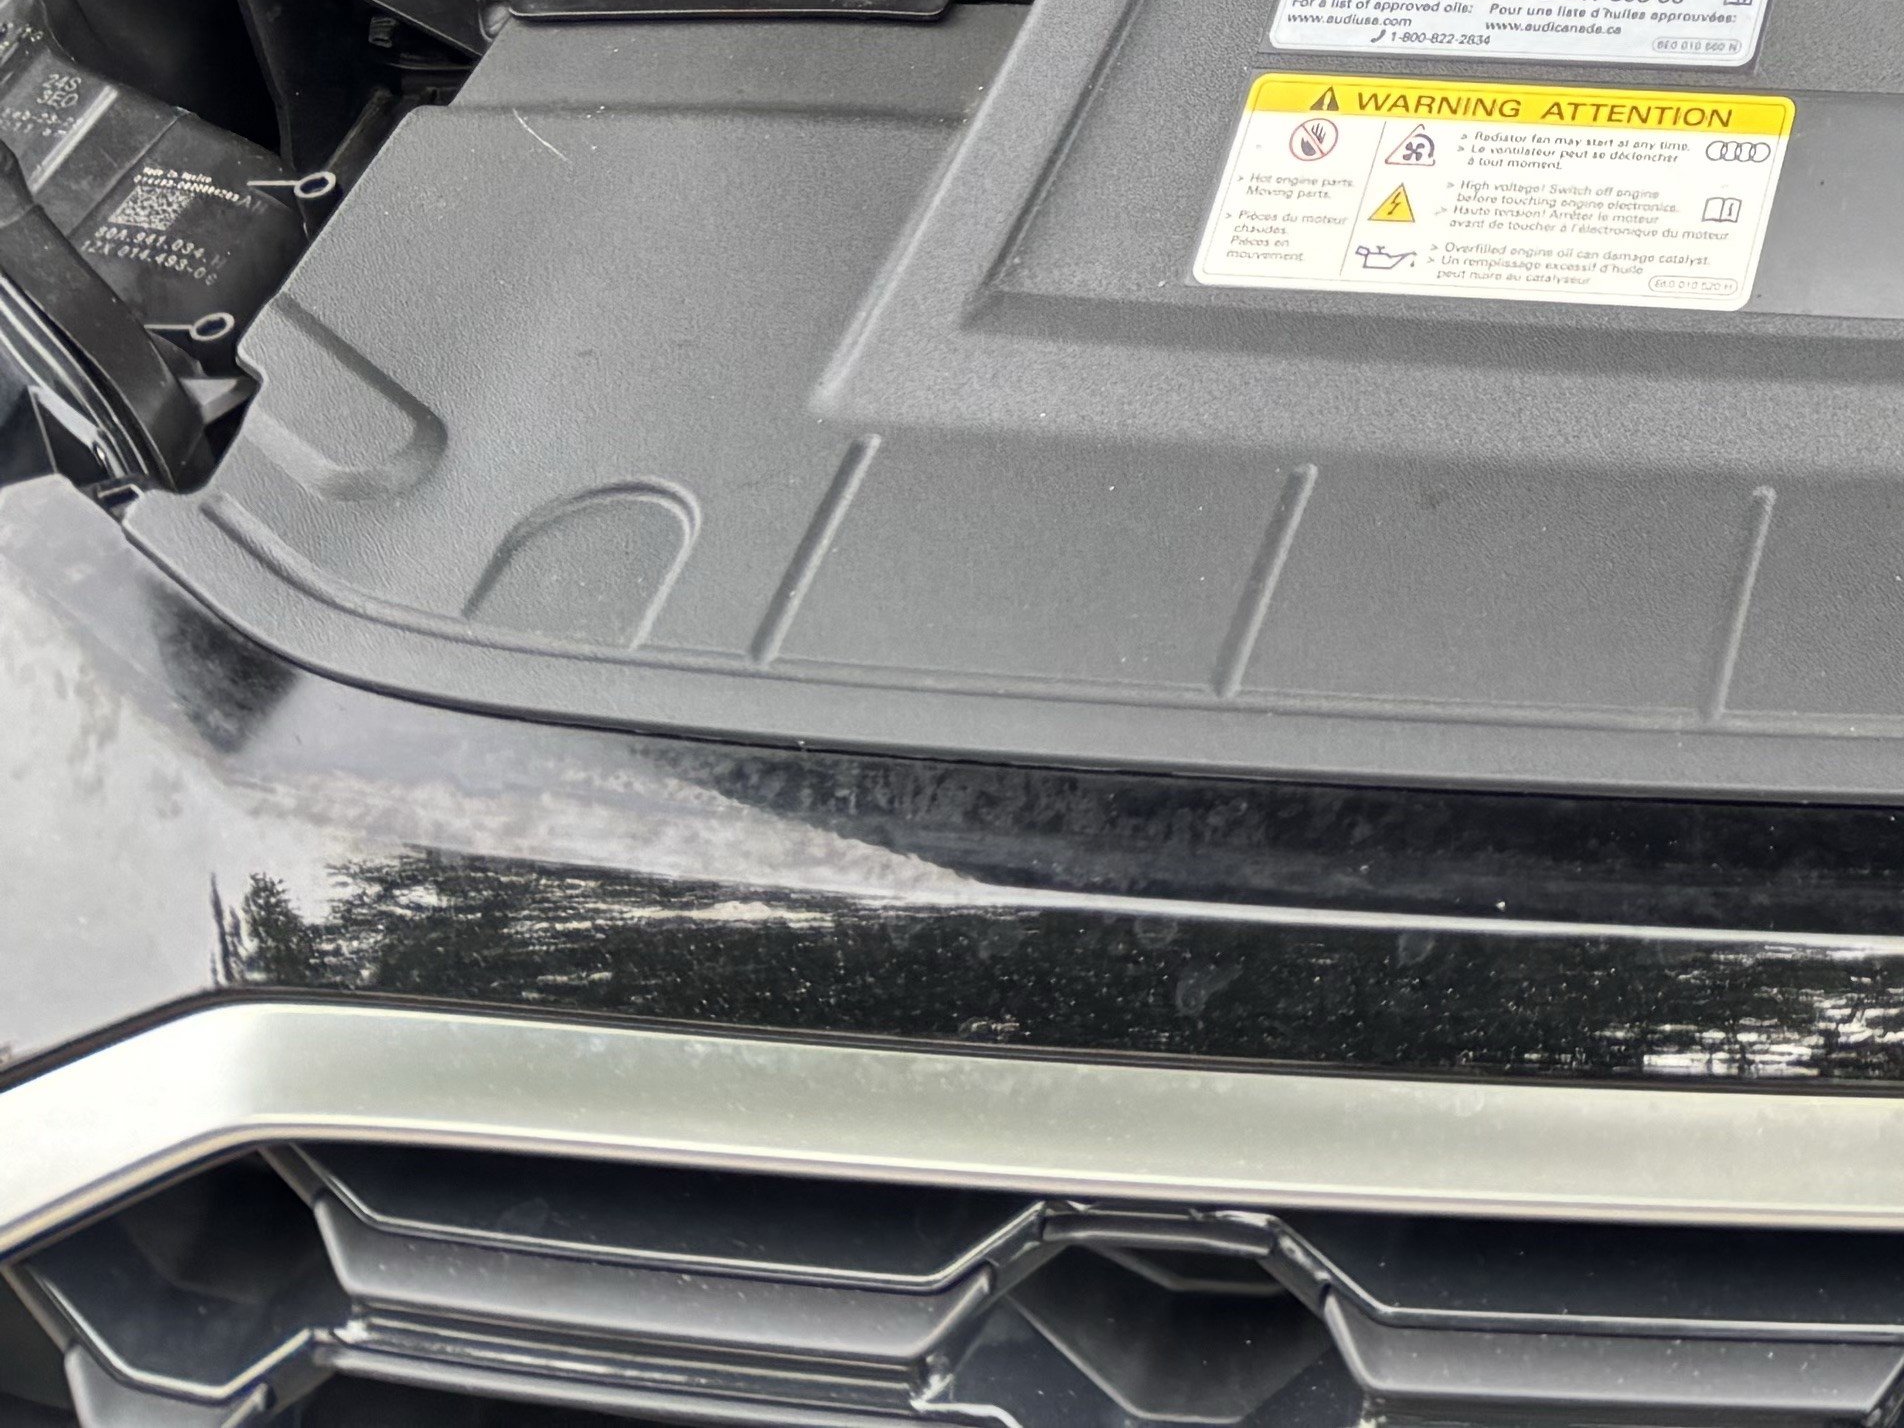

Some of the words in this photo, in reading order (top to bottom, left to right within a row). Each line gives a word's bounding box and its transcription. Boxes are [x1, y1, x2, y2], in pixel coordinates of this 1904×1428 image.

[1318, 0, 1327, 8] a
[1373, 0, 1440, 13] approved
[1443, 2, 1474, 14] oils:
[1489, 3, 1522, 16] Pour
[1527, 6, 1553, 16] une
[1557, 6, 1587, 18] liste
[1650, 11, 1737, 24] approuvées:
[1287, 12, 1412, 27] www.audiusa.com
[1485, 20, 1622, 35] www.audicanada.ca
[1356, 91, 1522, 120] WARNING
[1540, 101, 1733, 129] ATTENTION
[1475, 131, 1528, 143] Radiator
[1531, 133, 1551, 144] fan
[1554, 137, 1583, 148] may
[1586, 138, 1614, 147] start
[1617, 139, 1629, 148] at
[1633, 141, 1656, 151] any
[1659, 141, 1690, 151] time.
[1471, 144, 1486, 154] Le
[1490, 145, 1556, 157] ventilateur
[1559, 149, 1588, 160] peut
[1592, 151, 1606, 160] se
[1479, 158, 1503, 167] tout
[143, 167, 163, 177] Made
[1250, 173, 1272, 183] Hot
[1276, 176, 1318, 188] engine
[1246, 185, 1294, 199] Moving
[1460, 180, 1489, 193] High
[1494, 182, 1546, 195] voltage!
[1549, 183, 1592, 196] Switch
[1596, 187, 1614, 197] off
[1616, 189, 1660, 200] engine
[1457, 192, 1498, 204] before
[1502, 195, 1557, 208] touching
[1560, 199, 1604, 210] engine
[1282, 211, 1298, 222] du
[1302, 215, 1349, 225] moteur
[1453, 205, 1490, 216] Haute
[1598, 212, 1608, 221] le
[1612, 214, 1659, 224] moteur
[1449, 219, 1485, 228] avant
[1488, 220, 1504, 230] de
[1508, 221, 1556, 232] toucher
[1662, 228, 1678, 238] du
[1445, 241, 1507, 255] Overfilled
[1510, 247, 1553, 258] engine
[1557, 248, 1574, 258] oil
[1576, 250, 1599, 259] can
[1602, 250, 1655, 264] damage
[1442, 255, 1460, 265] Un
[1545, 260, 1596, 272] excessif
[1437, 270, 1465, 279] peut
